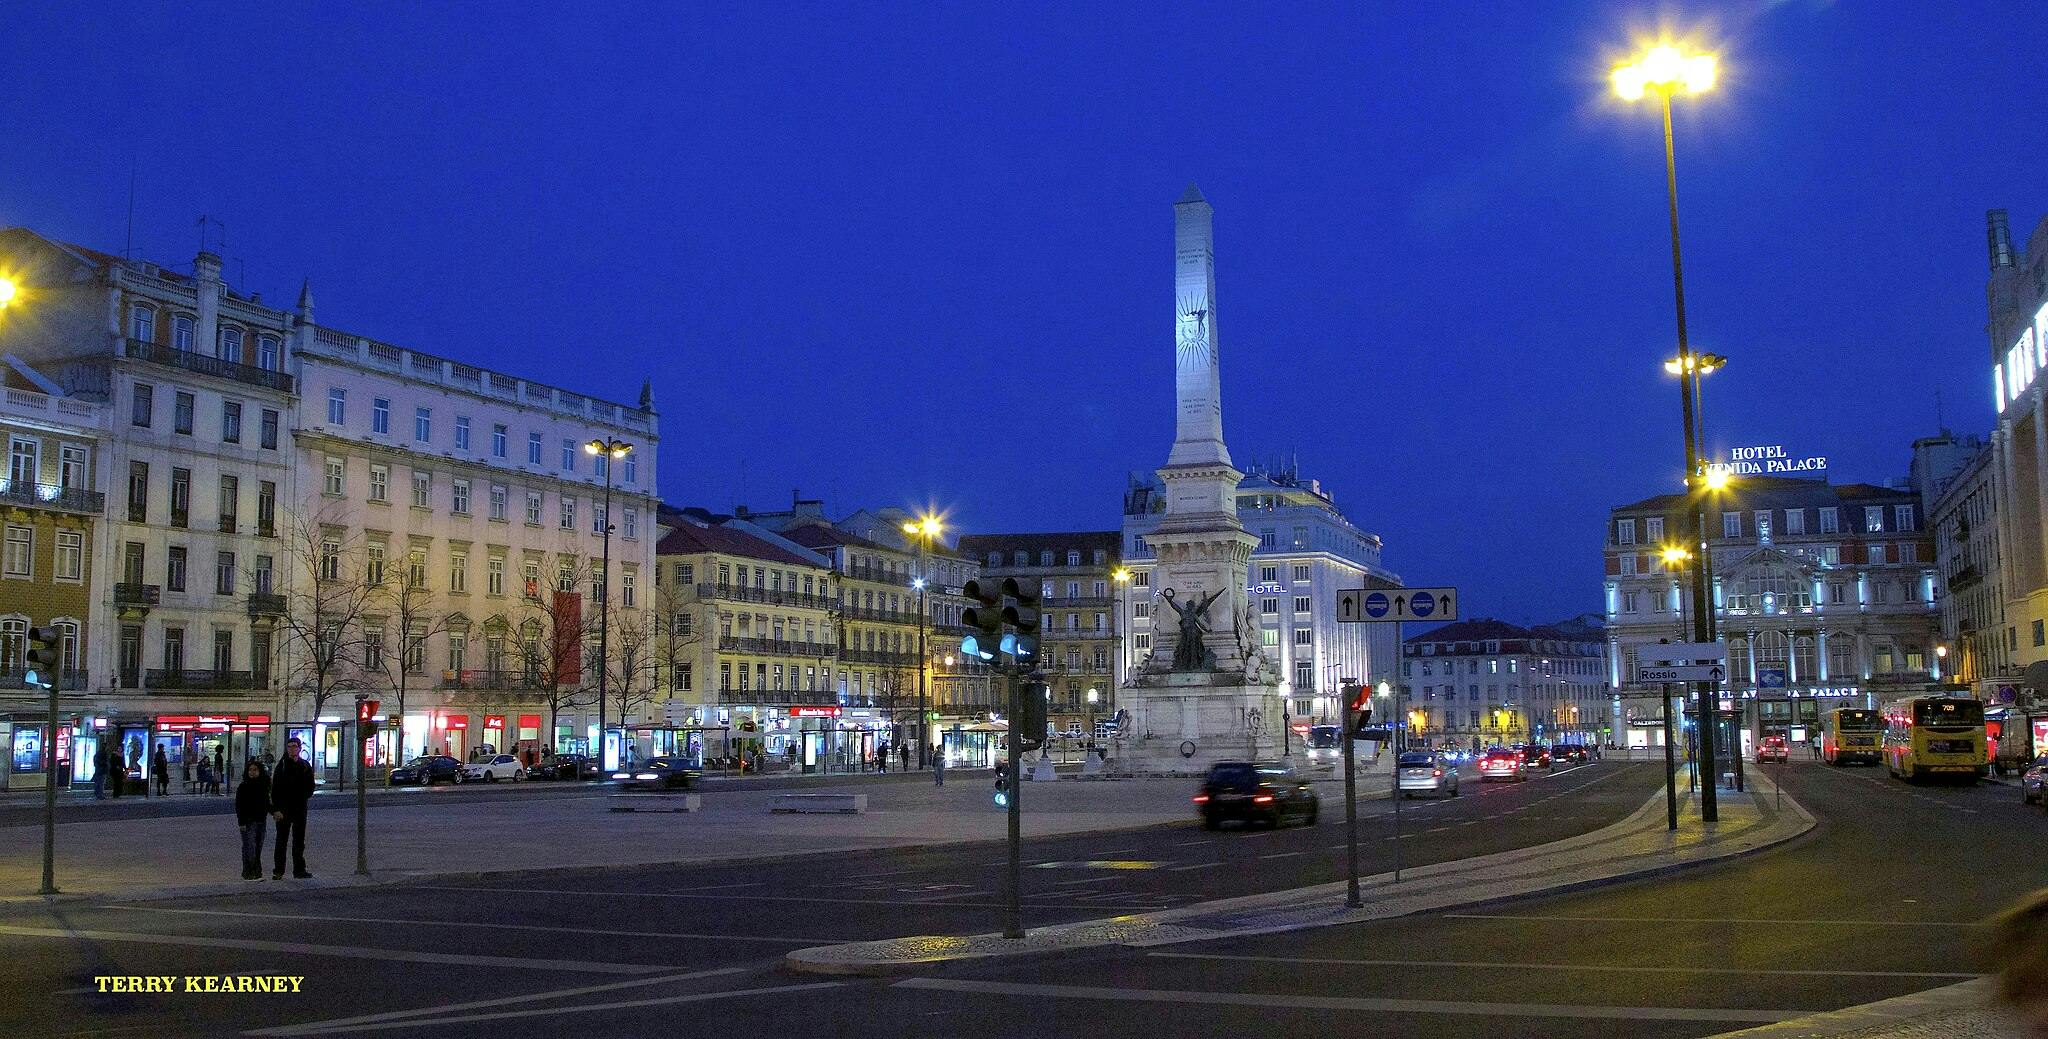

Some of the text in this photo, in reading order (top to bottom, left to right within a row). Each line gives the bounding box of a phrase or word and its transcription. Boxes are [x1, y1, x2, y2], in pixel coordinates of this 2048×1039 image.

[1731, 445, 1787, 460] HOTEL
[1766, 457, 1827, 473] PALACE
[1246, 585, 1287, 593] HOTEL
[1641, 670, 1677, 679] Rossio
[1810, 687, 1858, 697] PALACE
